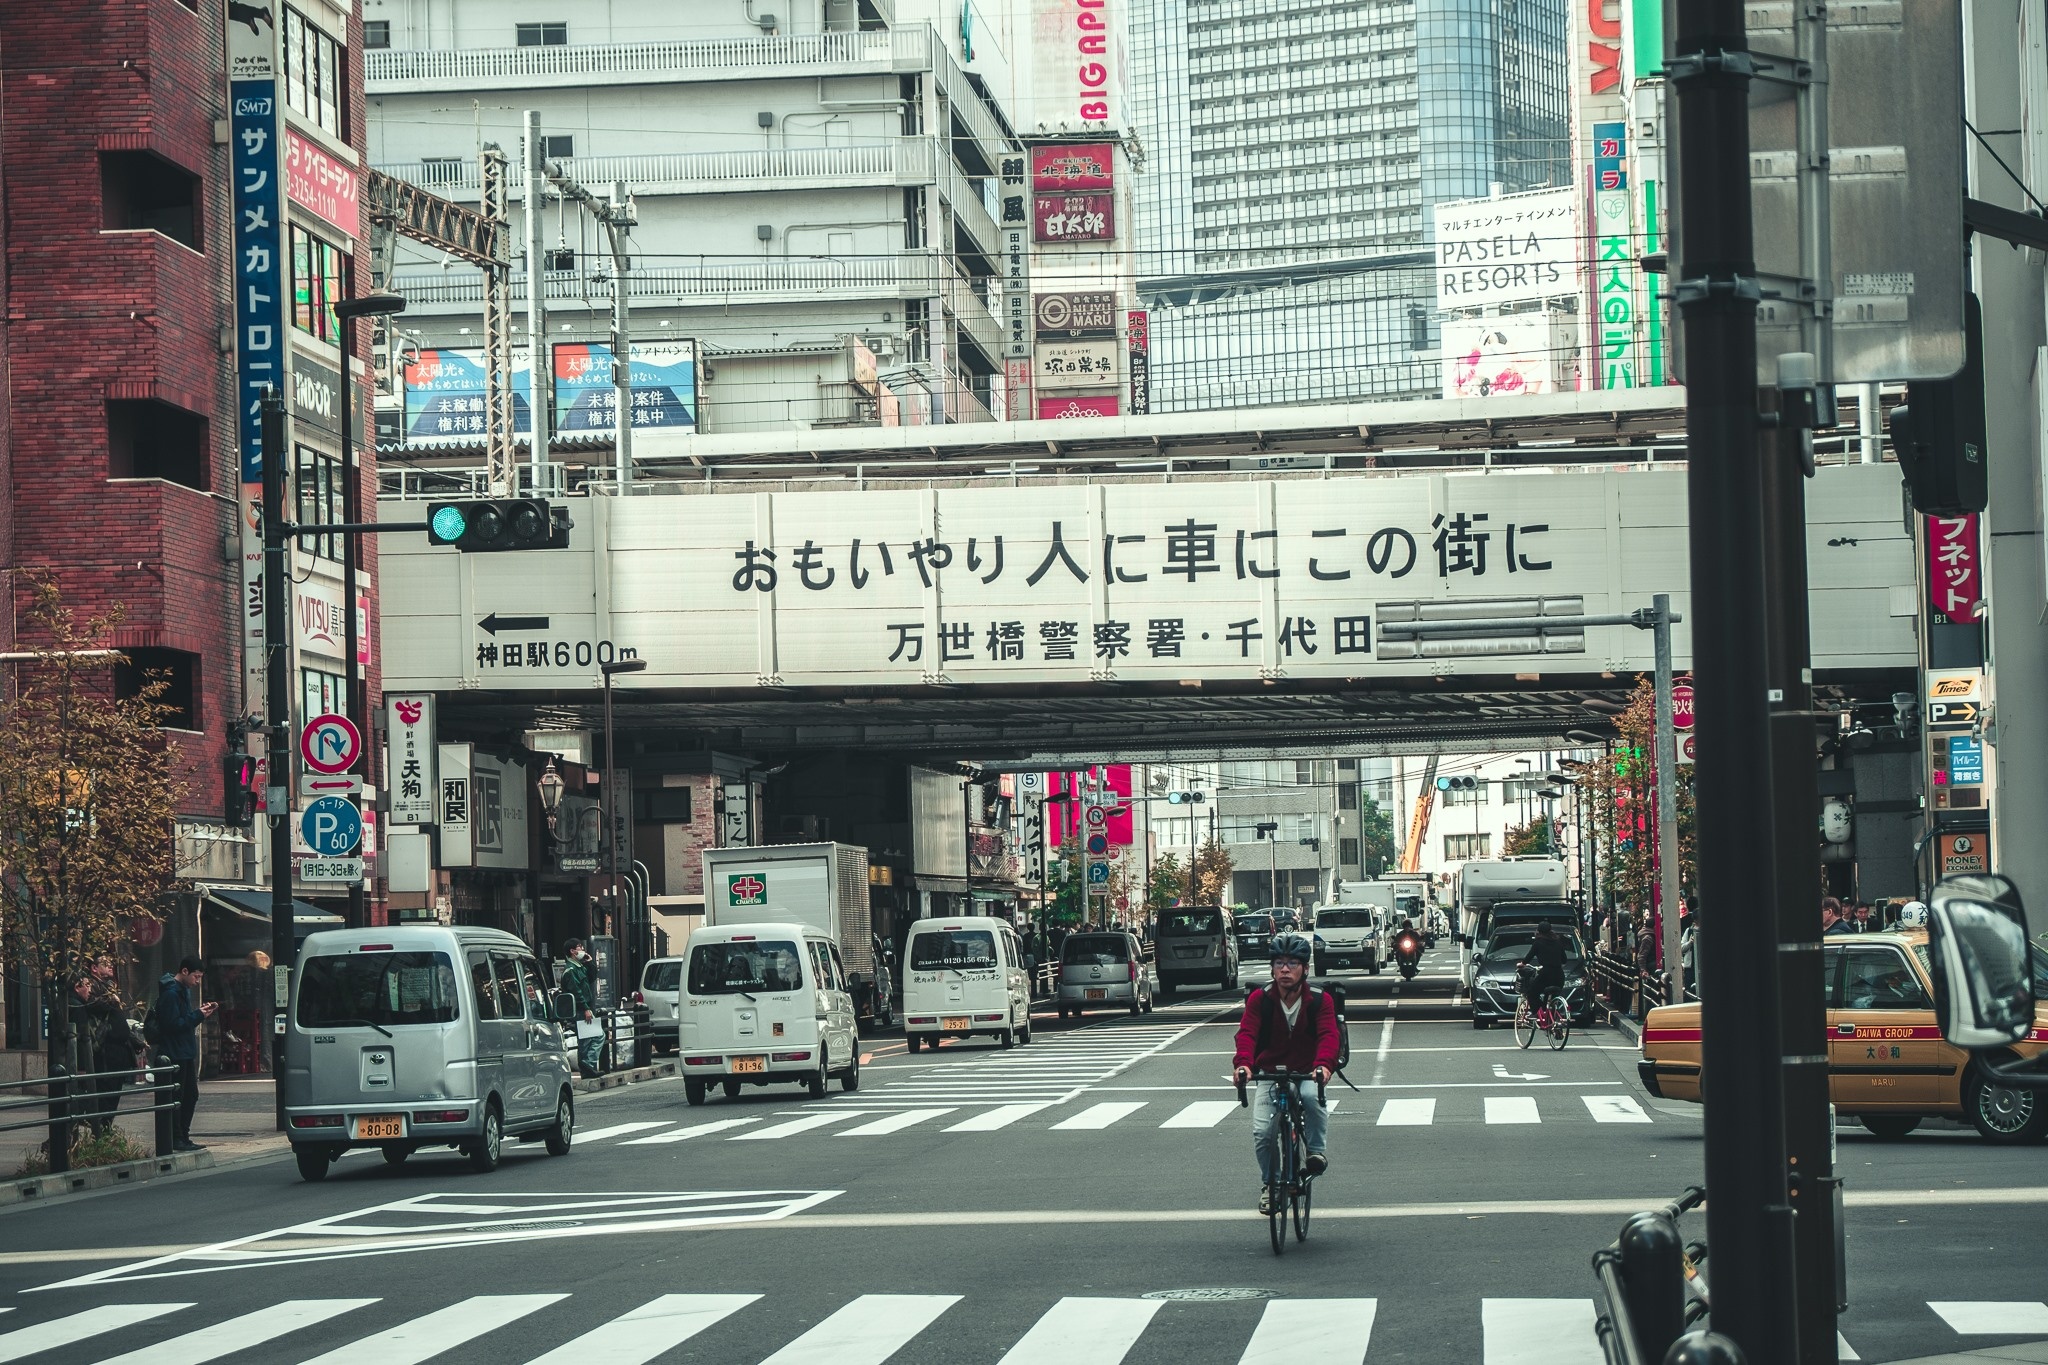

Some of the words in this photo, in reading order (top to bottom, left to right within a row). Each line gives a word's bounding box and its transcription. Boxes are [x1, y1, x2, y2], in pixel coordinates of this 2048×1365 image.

[1079, 62, 1108, 120] BIG
[241, 100, 266, 113] SMT
[1041, 163, 1105, 180] 北海道
[1602, 139, 1620, 190] カラ
[304, 144, 357, 203] ケイヨーテクノ
[1001, 157, 1026, 222] 朝風
[1038, 200, 1051, 210] 7F
[1044, 211, 1105, 236] 甘太郎
[1442, 205, 1576, 232] マルチエンターテインメント
[1441, 231, 1541, 265] PASELA
[1443, 260, 1561, 296] RESORTS
[1072, 303, 1111, 315] NIJYU
[1601, 235, 1633, 390] 大人のデパ
[1073, 314, 1112, 327] MARU
[1069, 329, 1082, 337] 6F
[1130, 315, 1147, 351] 北海道
[643, 345, 692, 357] アドバンス
[567, 373, 663, 385] あきらめてけない。
[588, 409, 664, 426] 権利集中
[1934, 614, 1947, 624] B1
[886, 615, 1372, 663] 万世橋警察署・千代田
[1936, 681, 1972, 694] Times
[1931, 704, 1947, 721] P
[1953, 755, 1980, 765] ハイルーフ
[401, 760, 421, 799] 天狗
[1934, 771, 1947, 785] 満
[319, 800, 345, 809] 9-19
[445, 780, 466, 822] 和民
[407, 813, 419, 821] B1
[315, 812, 338, 849] P
[348, 823, 355, 834] 分
[331, 832, 348, 850] 60
[1946, 855, 1982, 865] MONEY
[1946, 864, 1983, 872] EXCHANGE
[1856, 1029, 1881, 1037] DAIWA
[1885, 1029, 1914, 1037] GROUP
[738, 1063, 762, 1073] 81-96
[367, 1124, 400, 1136] 80-08
